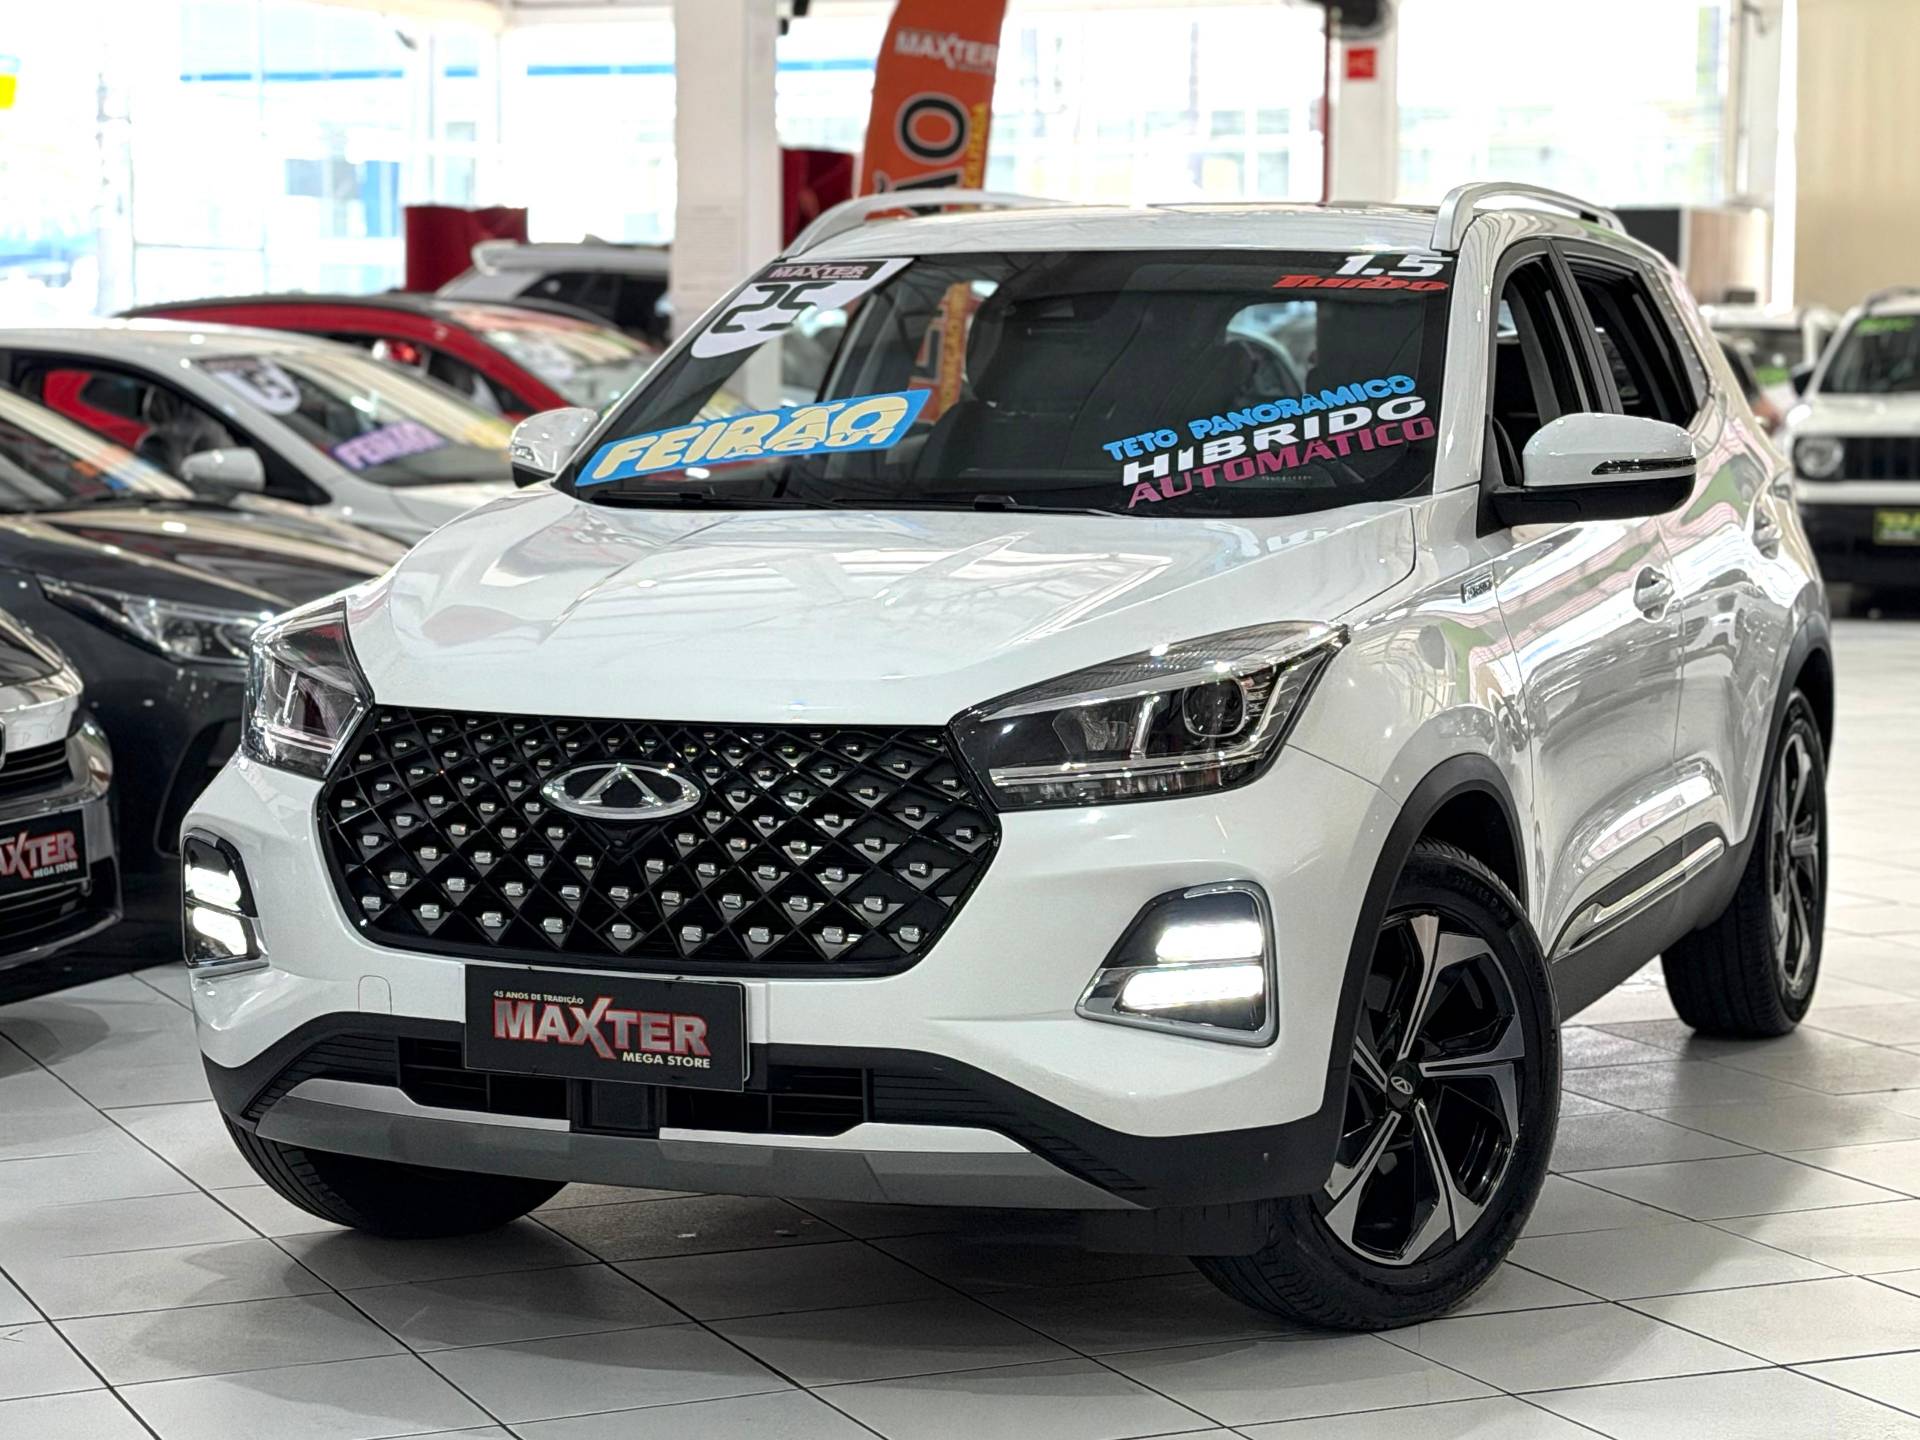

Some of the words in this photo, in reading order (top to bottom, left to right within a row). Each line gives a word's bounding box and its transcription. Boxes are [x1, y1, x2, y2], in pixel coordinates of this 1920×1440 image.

[895, 29, 999, 71] MAXTER
[768, 263, 869, 279] MAXTER
[1335, 254, 1453, 277] 1.5
[1272, 274, 1449, 291] Turbo
[710, 281, 837, 334] 25
[592, 396, 909, 480] FEIRÃO
[1103, 428, 1179, 461] TETO
[494, 990, 504, 998] 45
[505, 991, 529, 1000] ANOS
[530, 993, 542, 1001] DE
[493, 997, 713, 1060] MAXTER
[622, 1051, 664, 1065] MEGA
[667, 1055, 711, 1069] STORE
